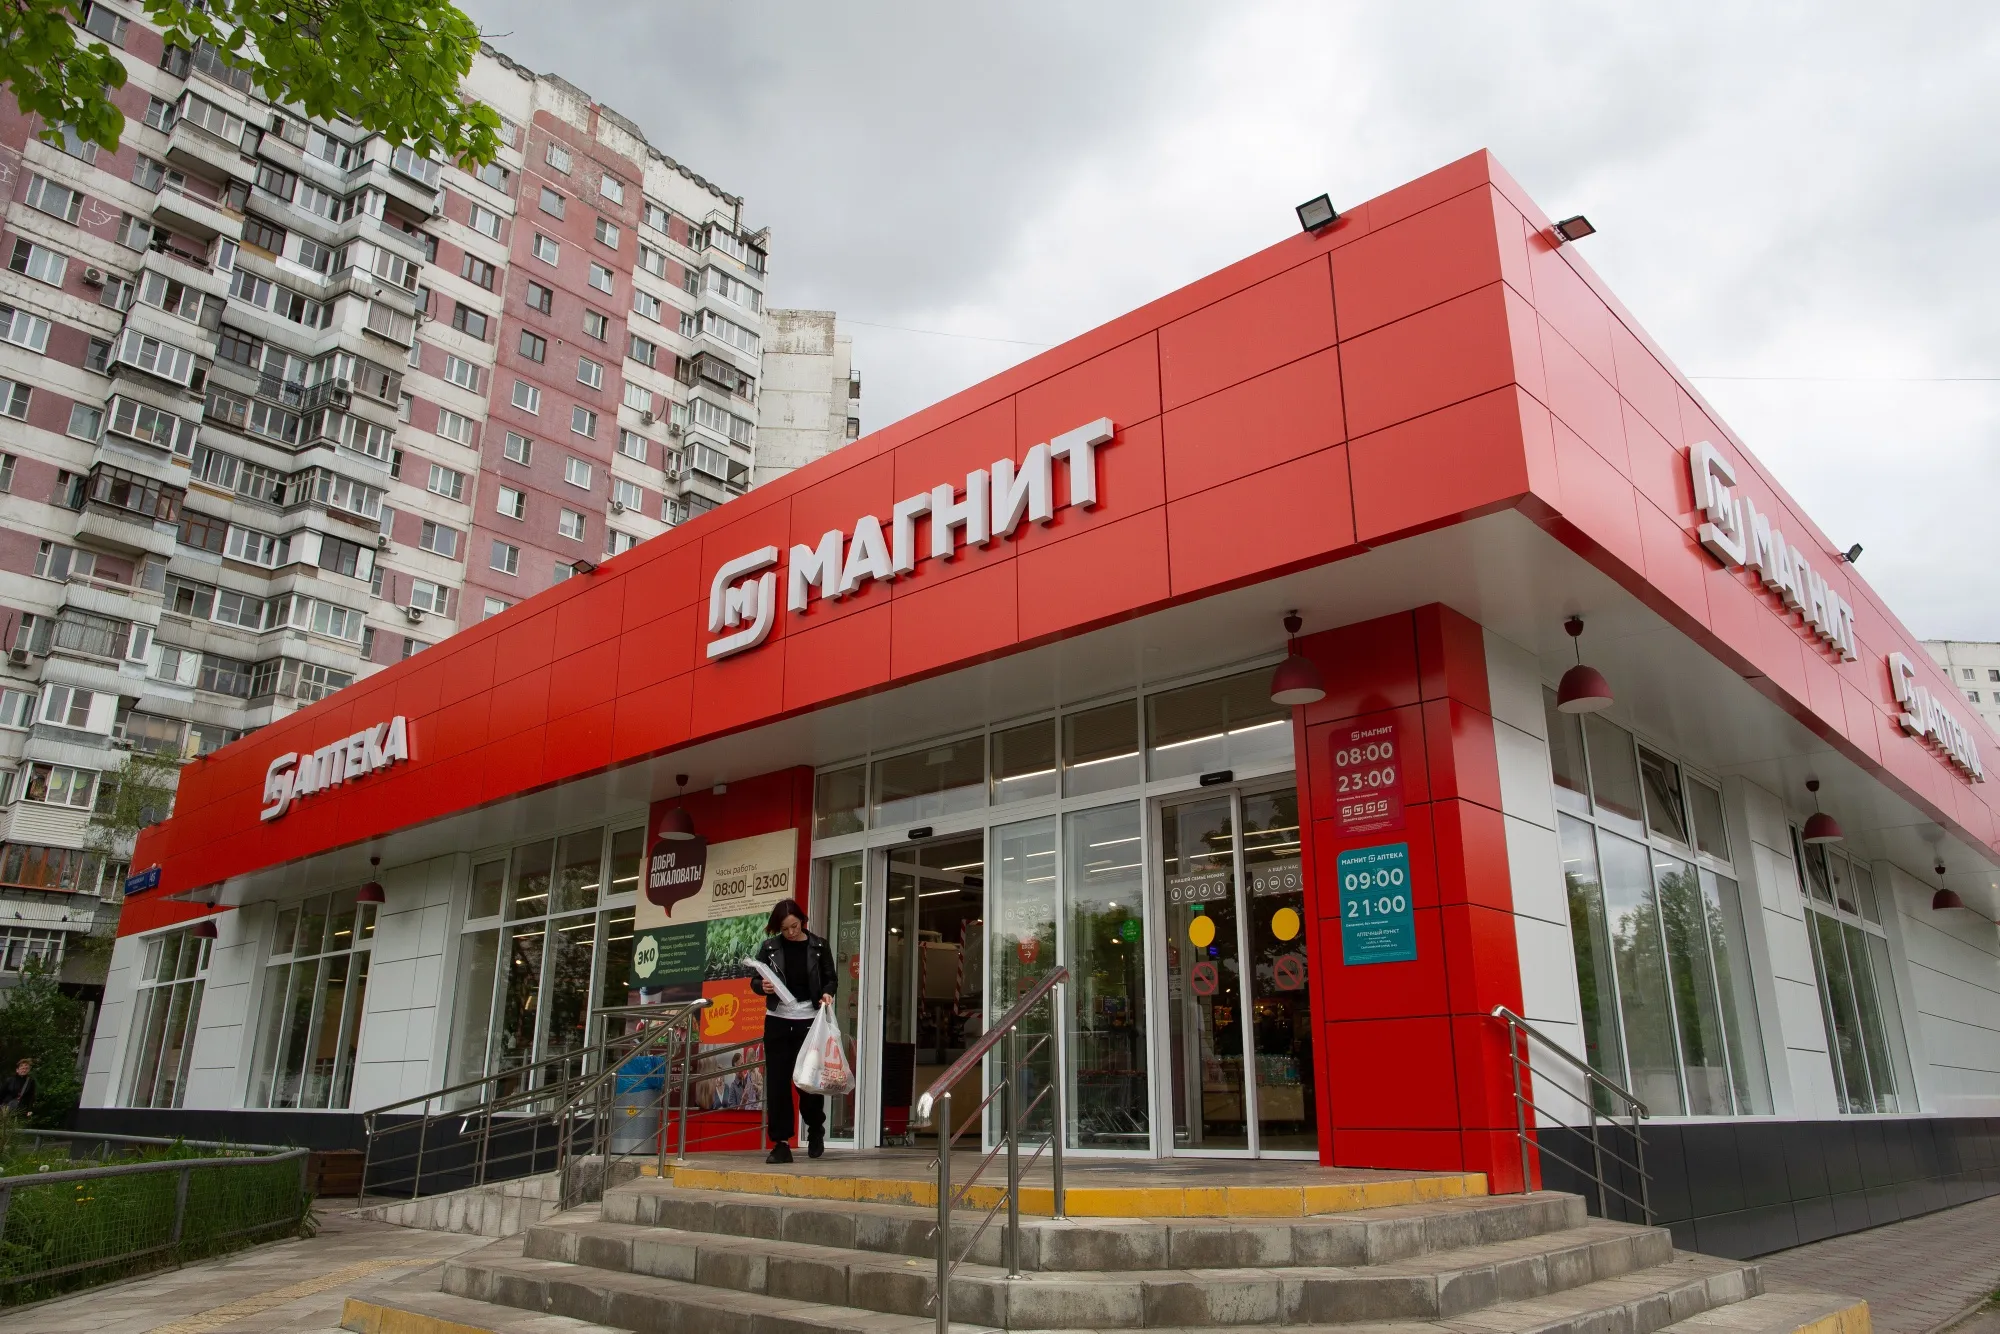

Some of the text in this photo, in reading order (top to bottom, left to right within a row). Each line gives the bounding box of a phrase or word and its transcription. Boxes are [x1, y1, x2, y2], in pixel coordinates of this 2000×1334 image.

[787, 416, 1114, 613] МАГНИТ
[1740, 495, 1858, 663] МАГНИТ
[1361, 725, 1393, 738] МАГНИТ
[291, 715, 408, 799] АПТЕКА
[1336, 742, 1393, 767] 08:00
[1338, 766, 1395, 792] 23:00
[651, 852, 676, 873] ДОБРО
[1341, 852, 1403, 865] МАГНИТ АПТЕКА
[649, 865, 702, 889] ПОЖАЛОВАТЬ!
[715, 867, 732, 877] Часы
[1345, 868, 1404, 891] 09:00
[714, 879, 745, 897] 08:00
[755, 872, 787, 891] 23:00
[1347, 895, 1406, 918] 21:00
[637, 948, 655, 965] ЭКО
[708, 1003, 730, 1020] КАФЕ
